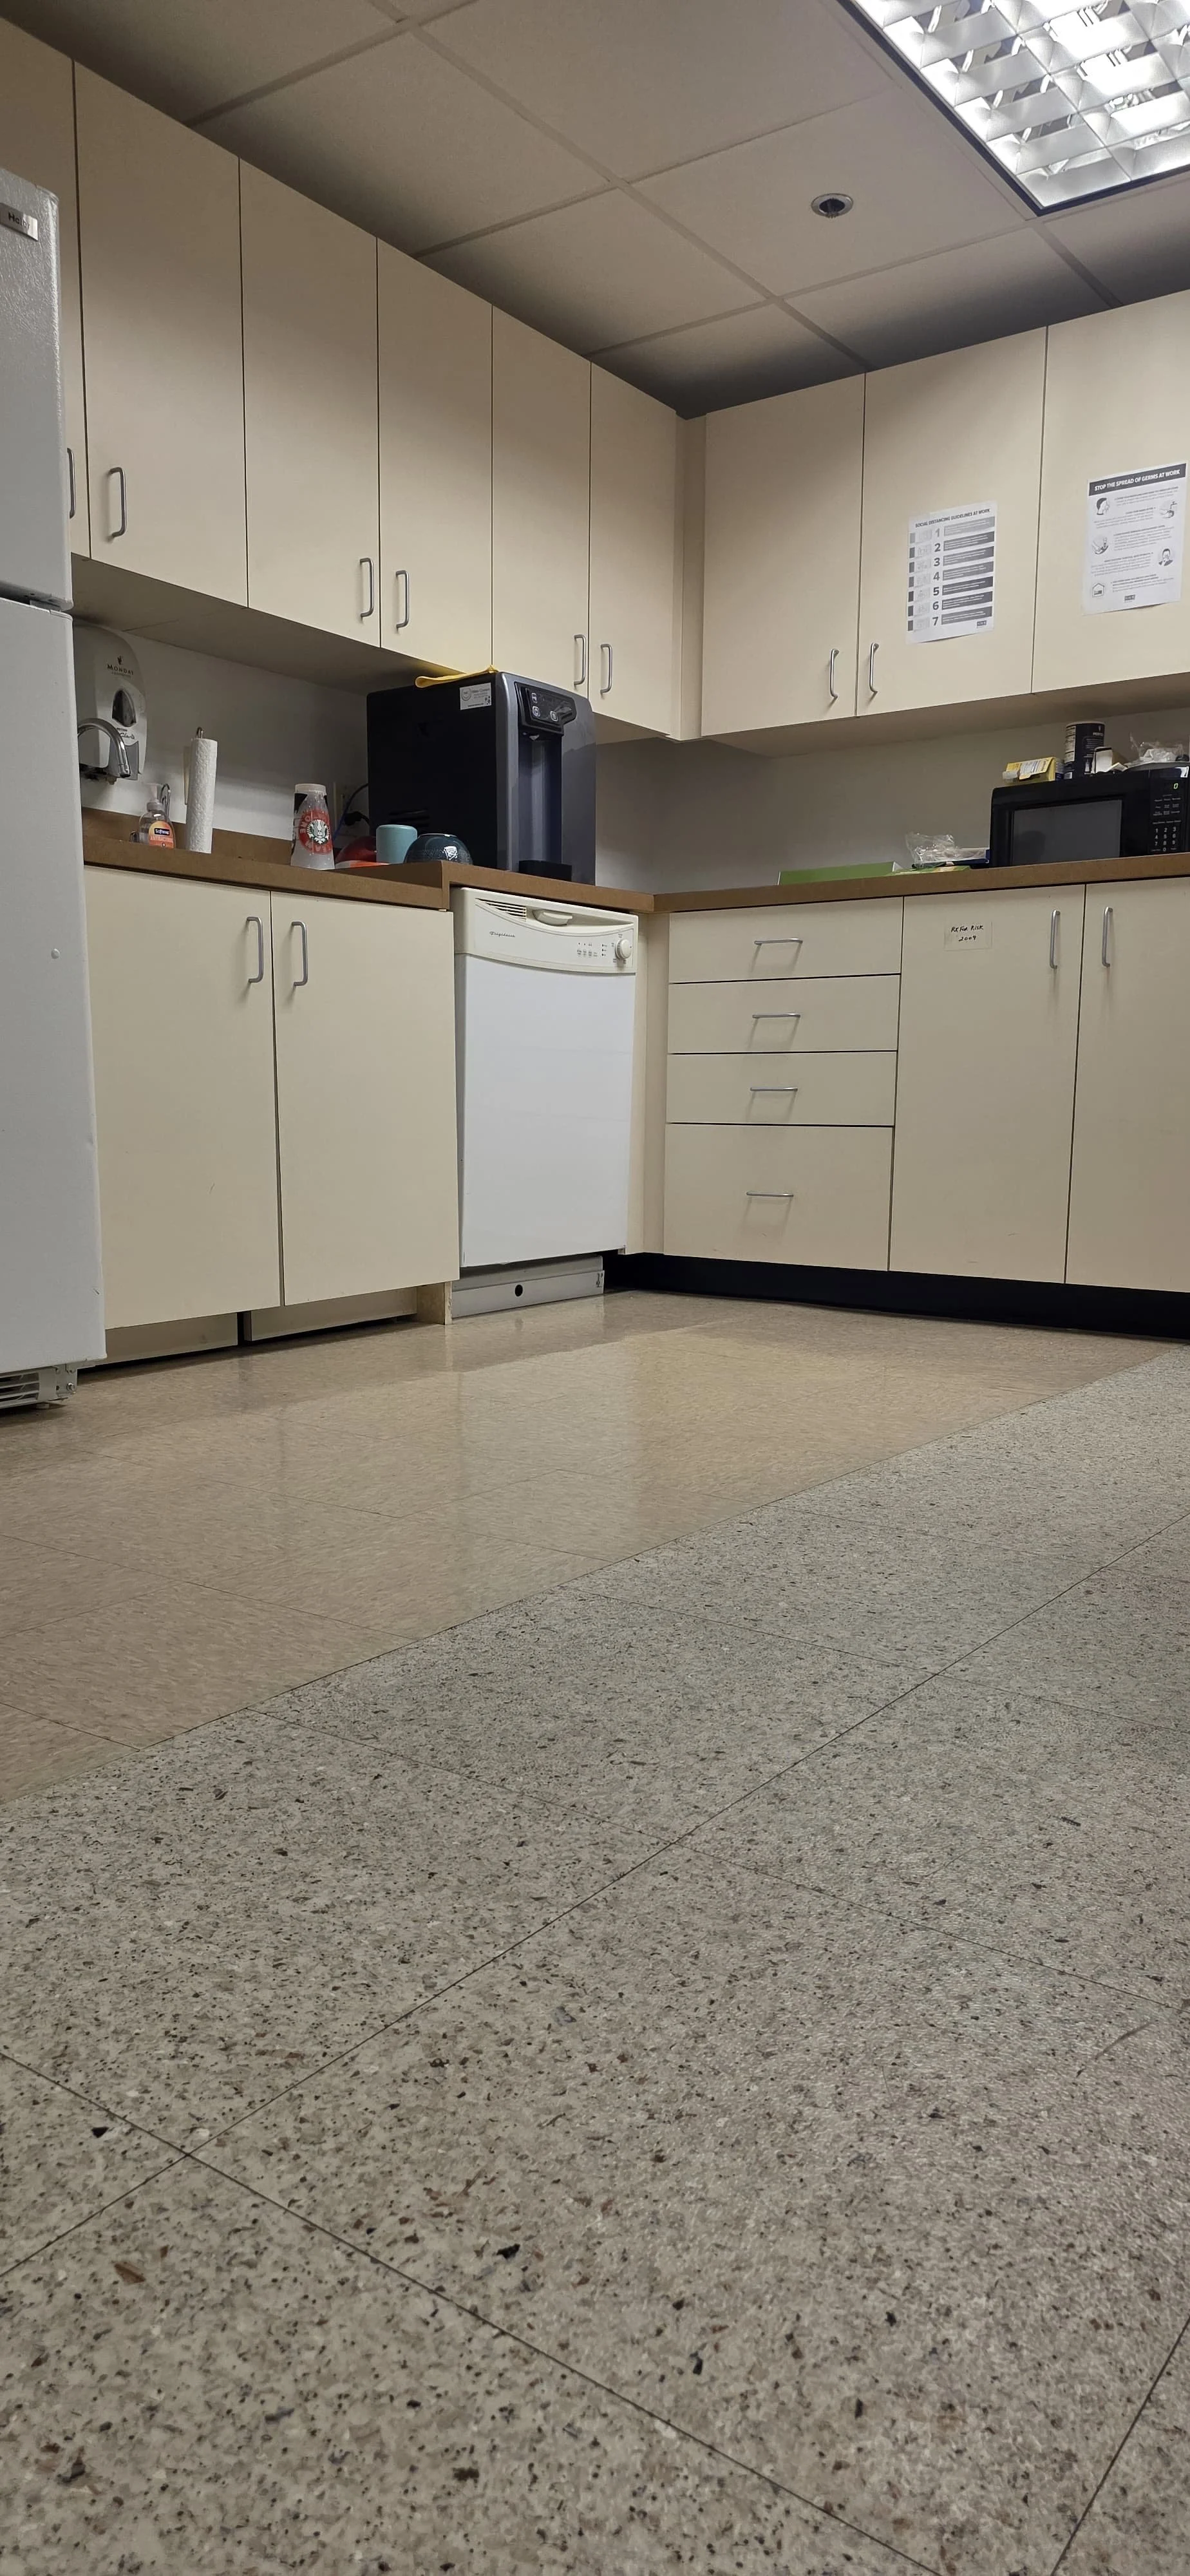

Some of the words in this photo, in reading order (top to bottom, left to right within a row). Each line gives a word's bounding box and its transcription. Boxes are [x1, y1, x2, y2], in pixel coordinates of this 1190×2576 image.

[1116, 478, 1134, 488] SPREAD
[1142, 473, 1158, 482] GERMS
[929, 516, 950, 525] DISTANCING
[951, 512, 972, 520] GUIDELINES
[935, 528, 940, 537] 1
[934, 543, 941, 553] 2
[934, 558, 940, 567] 3
[933, 571, 940, 581] 4
[933, 587, 940, 596] 5
[932, 601, 939, 610] 6
[932, 616, 938, 626] 7
[107, 664, 134, 676] MONDAY
